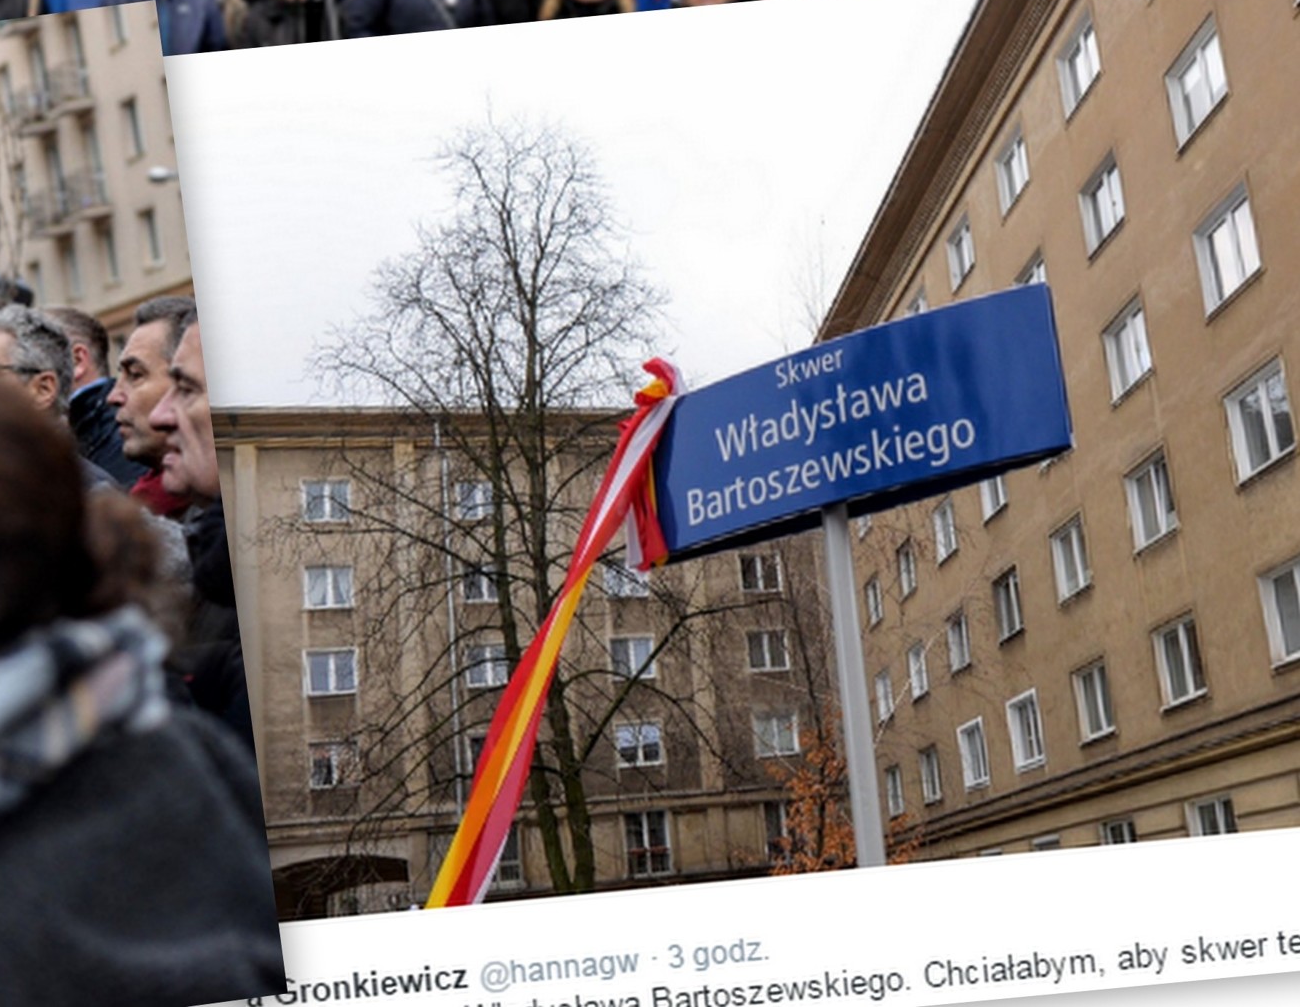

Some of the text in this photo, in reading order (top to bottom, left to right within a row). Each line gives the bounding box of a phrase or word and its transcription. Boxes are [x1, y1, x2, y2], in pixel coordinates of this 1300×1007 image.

[774, 349, 844, 389] Skwer
[715, 371, 929, 463] Władysława
[687, 417, 976, 527] Bartoszewskiego
[480, 953, 639, 993] @hannagw
[667, 943, 685, 969] 3
[692, 939, 769, 971] godz.
[651, 969, 911, 1007] Bartoszewskiego.
[923, 950, 1107, 989] Chciałabym,
[1118, 941, 1169, 975] aby
[1181, 936, 1269, 965] skwer
